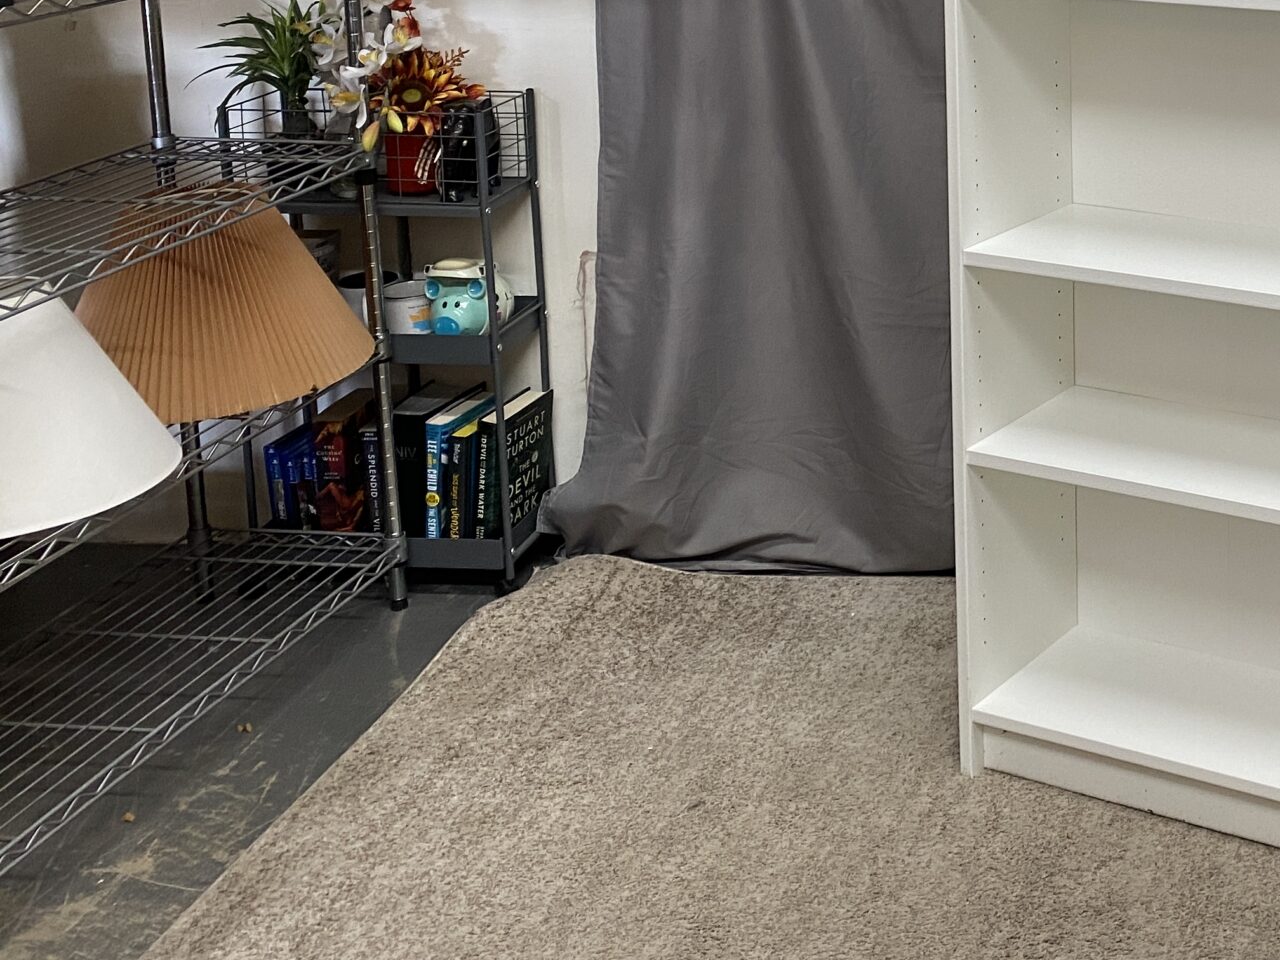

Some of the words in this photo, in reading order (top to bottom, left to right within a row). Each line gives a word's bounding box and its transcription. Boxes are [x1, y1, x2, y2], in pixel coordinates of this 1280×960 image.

[506, 410, 545, 445] STUART
[506, 425, 544, 459] TURTON
[427, 440, 437, 453] LEE
[427, 469, 437, 490] CHILD
[519, 459, 530, 472] THE
[367, 454, 378, 498] SPLENDID
[373, 518, 381, 532] VIL
[508, 464, 541, 499] DEVIL
[477, 492, 485, 519] WATER
